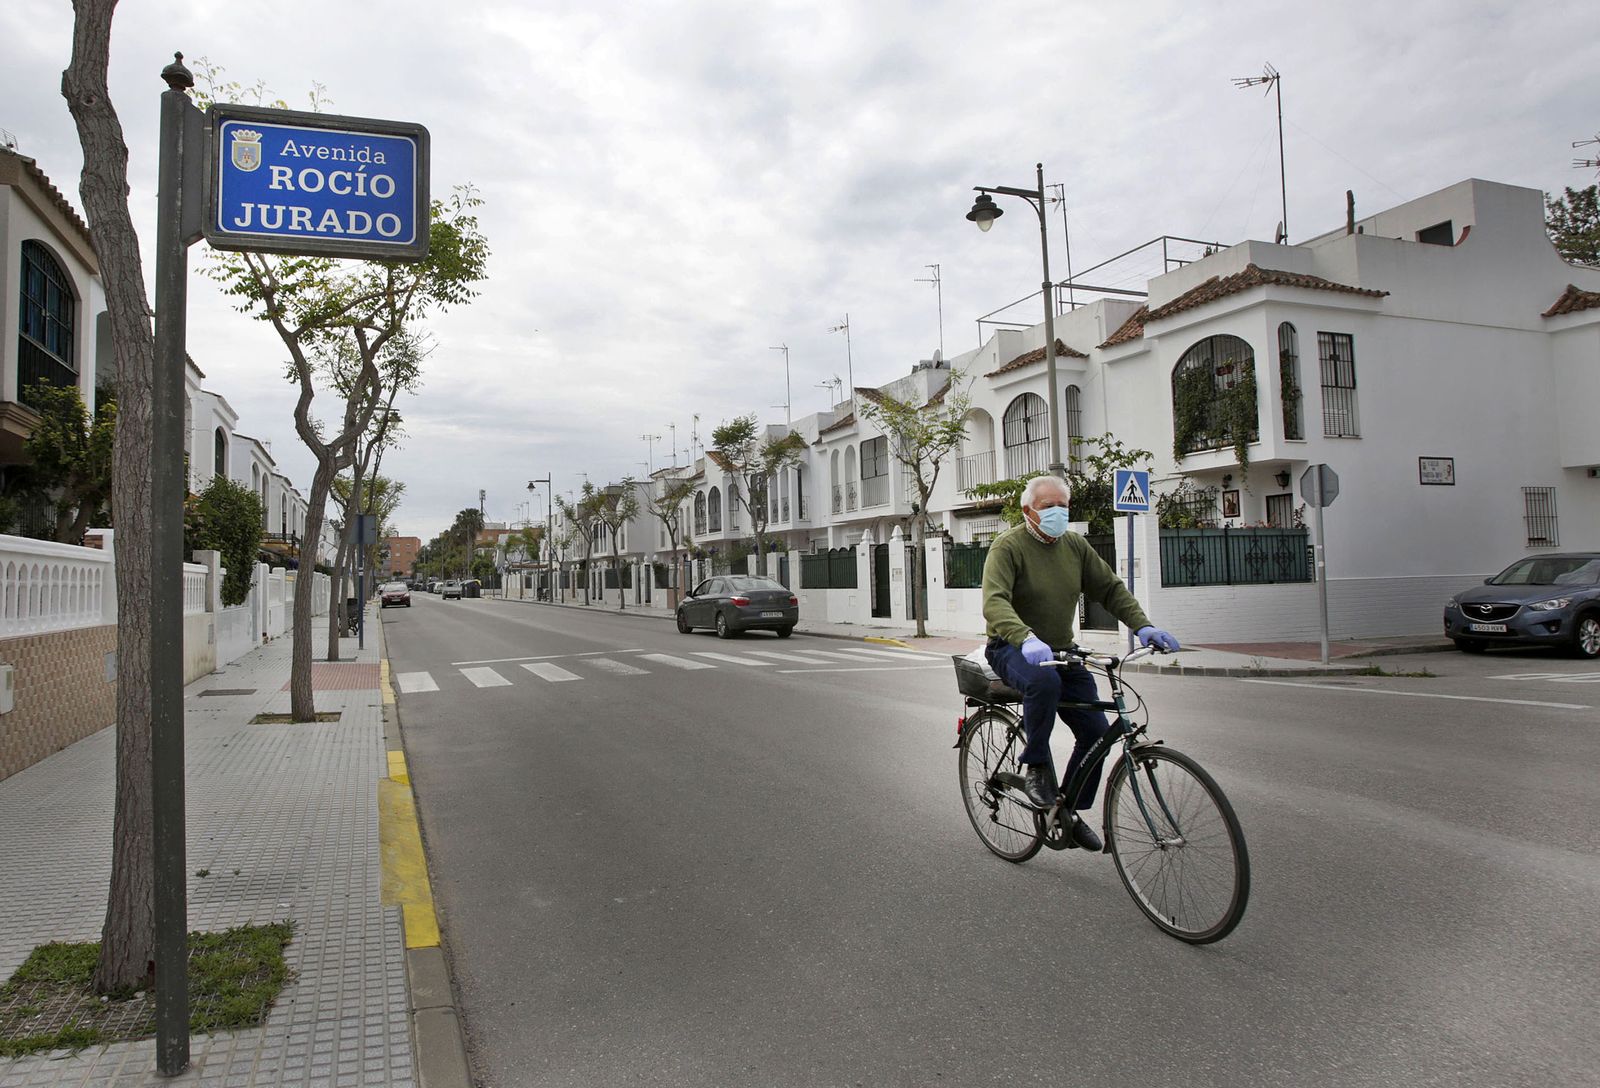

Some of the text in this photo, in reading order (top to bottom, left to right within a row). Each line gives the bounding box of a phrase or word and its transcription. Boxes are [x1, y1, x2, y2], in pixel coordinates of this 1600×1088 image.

[280, 140, 386, 164] Avenida
[269, 165, 395, 198] ROCÍO
[235, 203, 401, 236] JURADO
